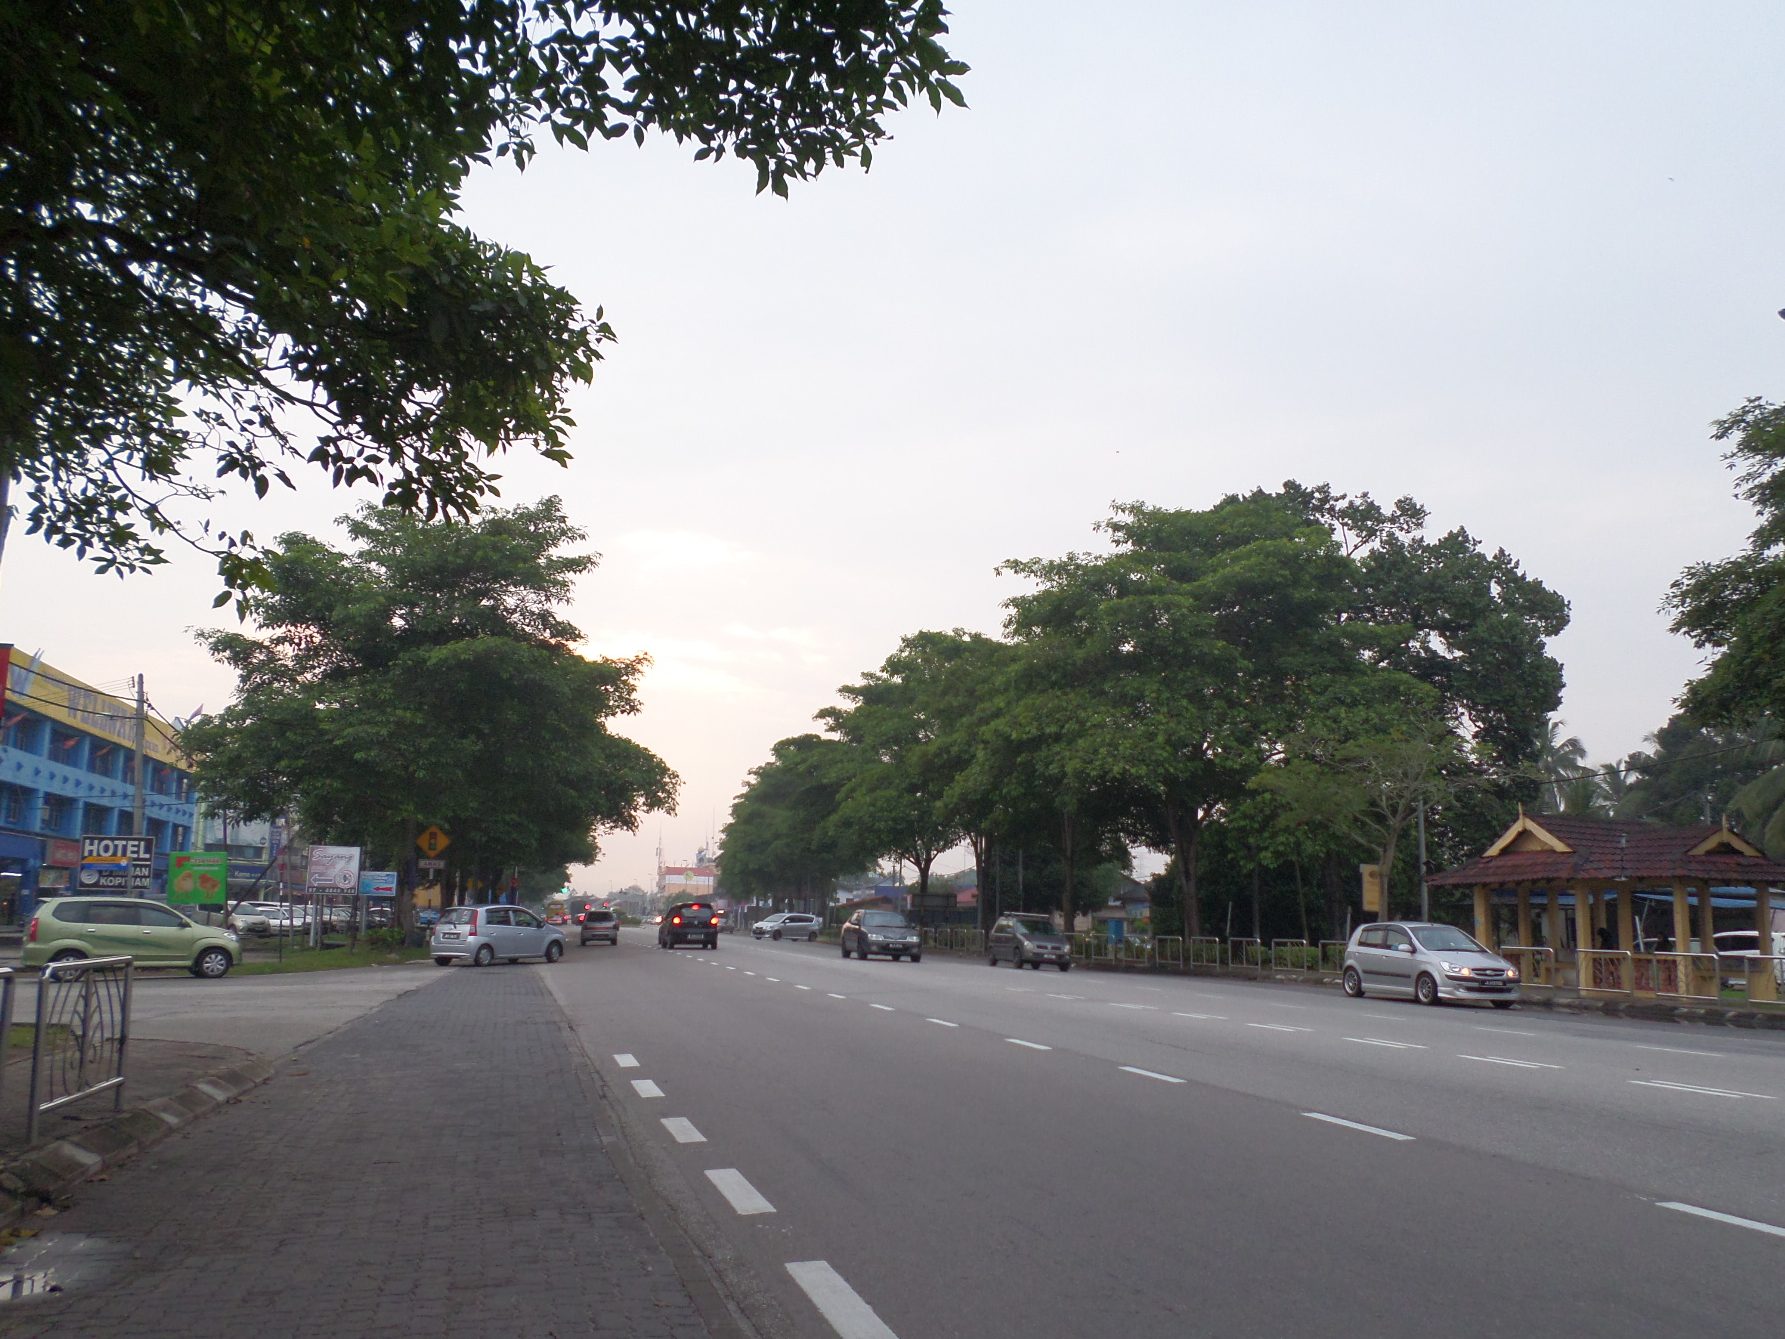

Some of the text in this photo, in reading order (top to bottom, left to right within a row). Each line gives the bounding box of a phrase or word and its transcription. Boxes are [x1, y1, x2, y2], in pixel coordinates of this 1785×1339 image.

[84, 840, 150, 858] HOTEL
[312, 848, 353, 866] Sayang
[99, 877, 150, 886] KOPIIAM
